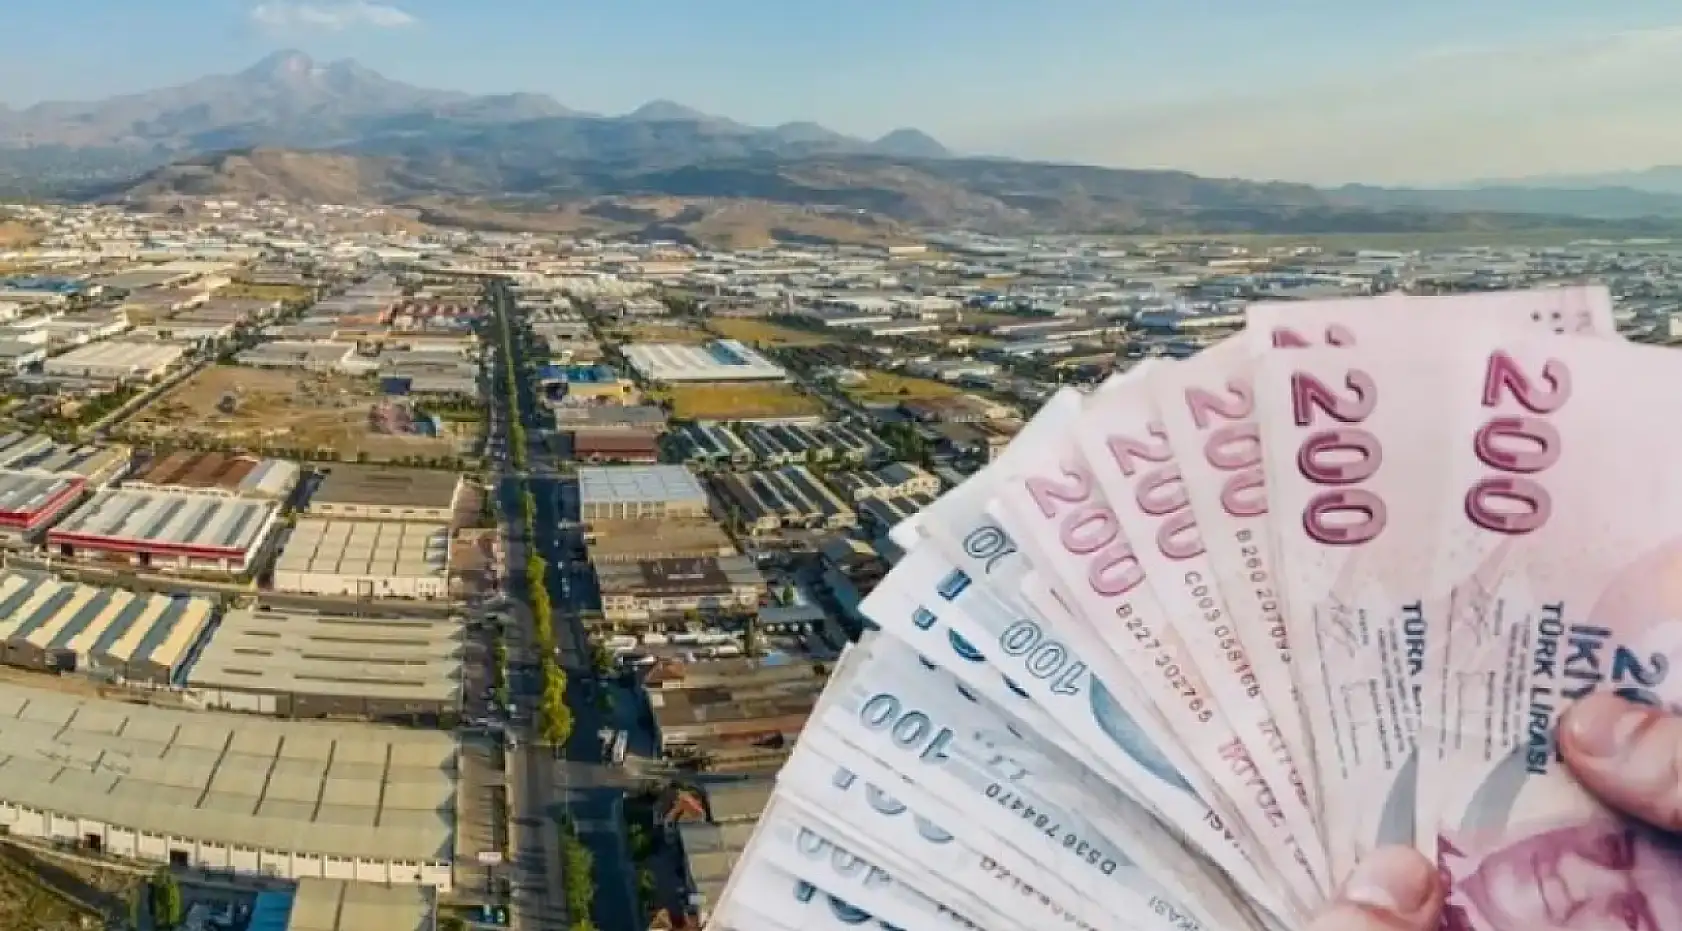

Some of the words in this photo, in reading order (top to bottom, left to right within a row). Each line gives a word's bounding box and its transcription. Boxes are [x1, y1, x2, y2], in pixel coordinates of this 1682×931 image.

[1106, 421, 1206, 559] 200
[1185, 379, 1268, 516] 200
[1291, 368, 1386, 545] 200
[1465, 350, 1572, 534] 200
[1025, 458, 1146, 596] 200
[999, 618, 1087, 697] 100
[1533, 601, 1564, 679] TÜRK
[859, 693, 953, 763] 100
